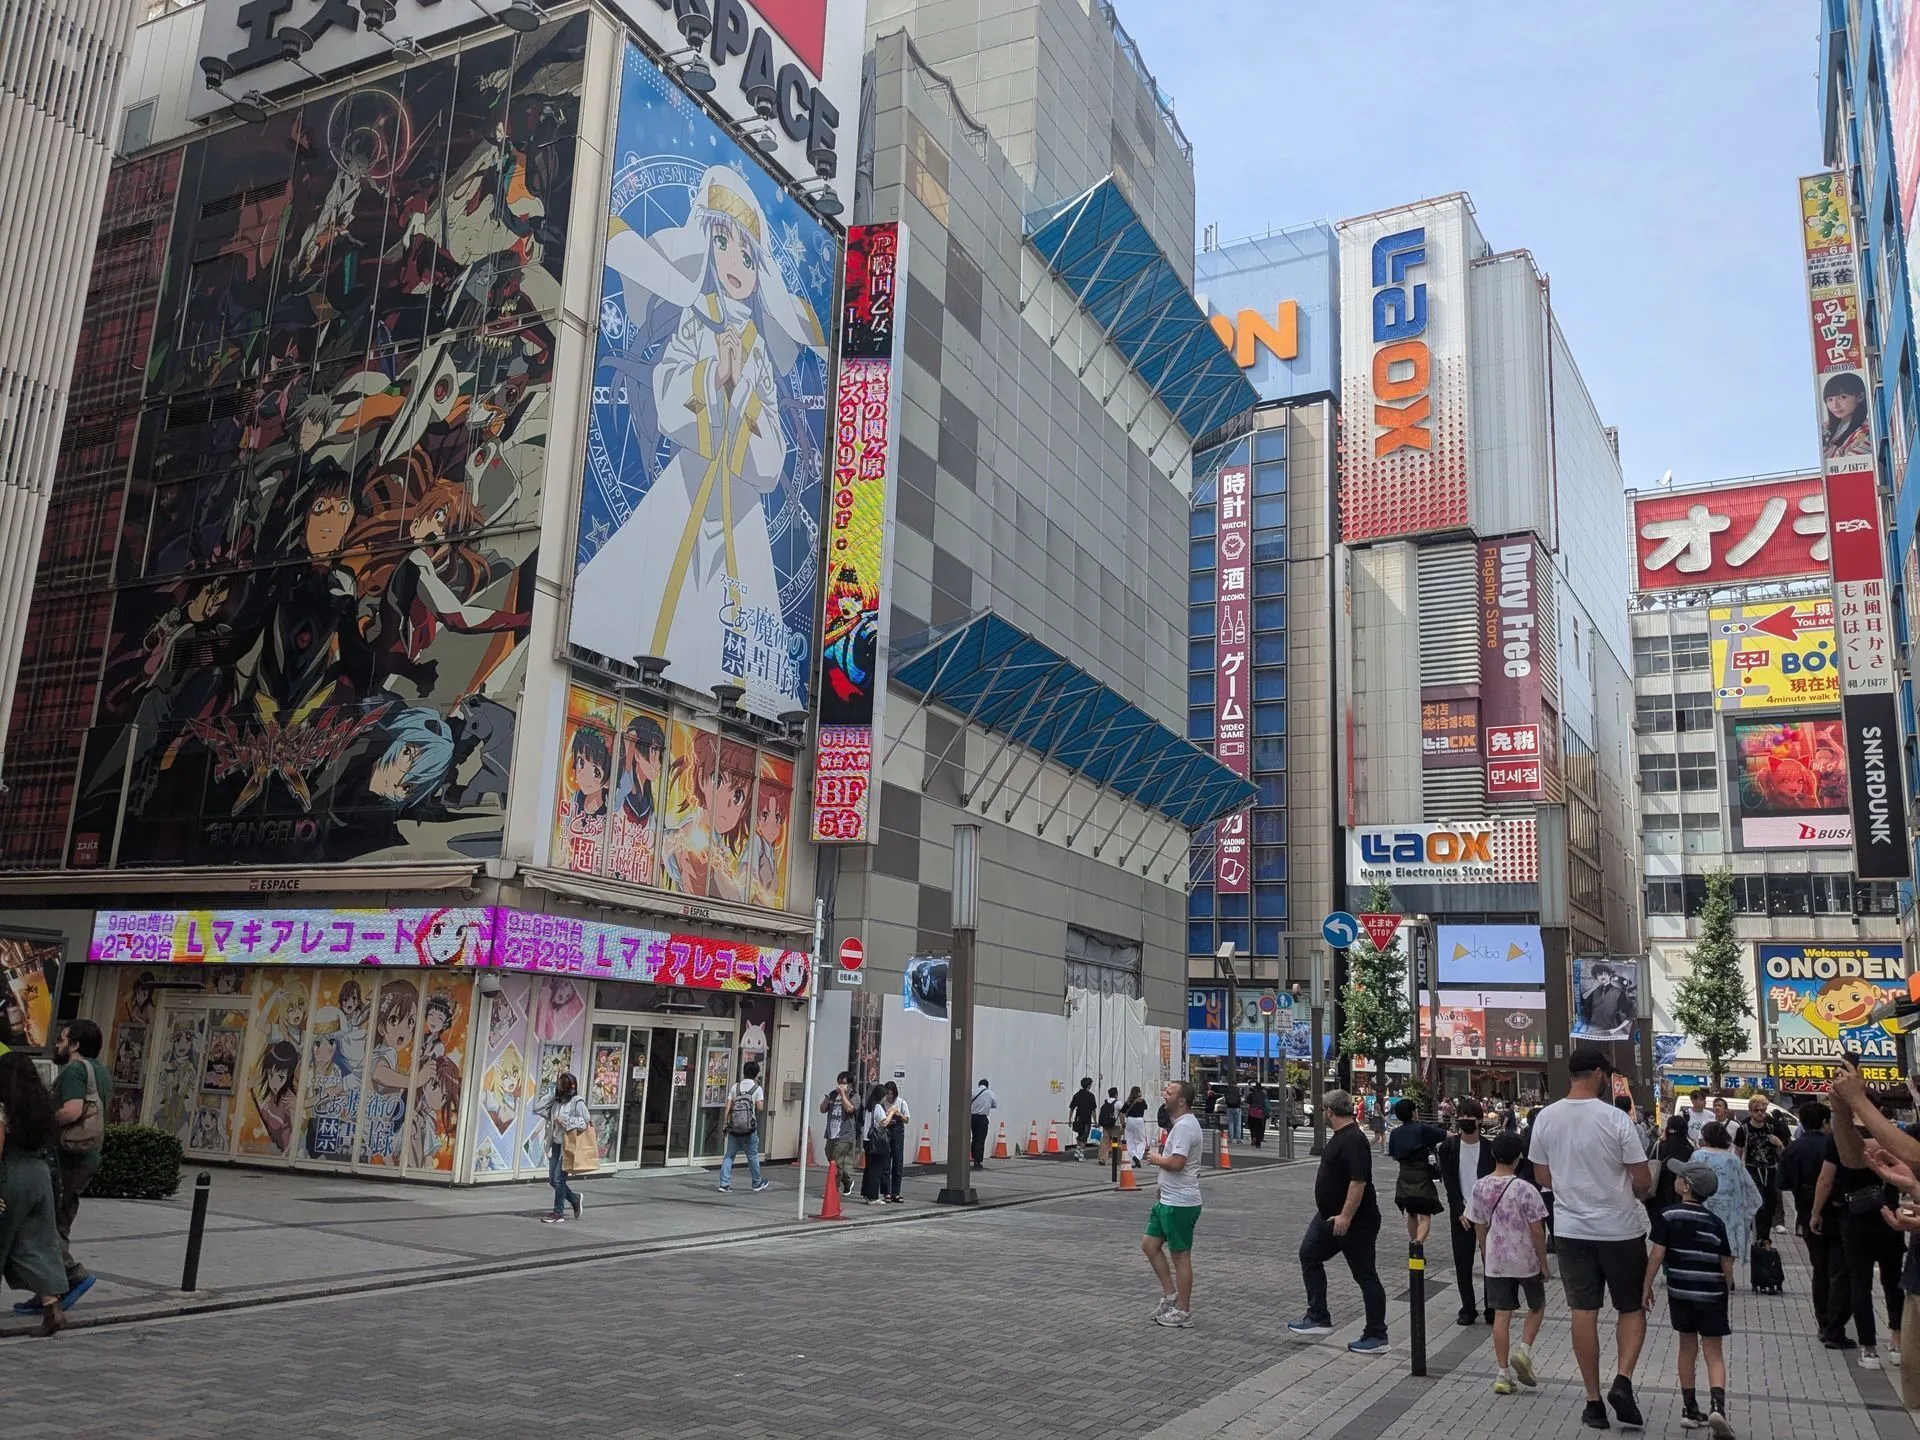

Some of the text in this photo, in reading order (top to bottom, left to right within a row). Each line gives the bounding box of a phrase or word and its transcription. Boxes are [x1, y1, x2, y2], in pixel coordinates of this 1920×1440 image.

[655, 0, 840, 178] PACE
[1811, 268, 1855, 288] 麻雀
[1222, 472, 1246, 520] 時計
[1221, 520, 1247, 530] WATCH
[1835, 519, 1872, 533] PSA
[720, 573, 748, 594] スマスロ
[1222, 566, 1246, 591] 酒
[1220, 594, 1246, 602] ALCOHOL
[1482, 547, 1499, 649] Flagship Store
[1498, 543, 1534, 678] Duty Free
[1816, 603, 1834, 616] 現
[719, 586, 808, 661] とある魔術の
[1797, 617, 1835, 627] You are
[1862, 581, 1885, 669] 和風耳かき
[721, 629, 801, 700] 禁書目録
[744, 676, 779, 693] インデックス
[1221, 651, 1245, 721] ゲーム
[1790, 676, 1840, 692] 現在地
[1847, 678, 1888, 689] 和ノ国7F
[1809, 693, 1831, 701] walk
[1422, 703, 1449, 716] 本店
[1220, 723, 1245, 731] VIDEO
[1422, 715, 1476, 731] 総合家電
[1220, 730, 1244, 738] GAME
[1490, 730, 1536, 752] 免税
[1490, 767, 1538, 785] 면세점
[1862, 726, 1892, 845] SNKRDUNK
[1219, 838, 1245, 846] TRADING
[1224, 845, 1241, 853] CARD
[1360, 865, 1493, 878] Home Electronics Store
[260, 879, 300, 891] ESPACE
[690, 907, 710, 918] ESPACE
[108, 913, 175, 933] 9月8日増台
[1367, 918, 1394, 927] 止まれ
[187, 918, 418, 954] Lマギアレコード
[1372, 928, 1390, 937] STOP
[1803, 948, 1869, 958] Welcome to
[1766, 956, 1906, 979] ONODEN
[315, 1116, 395, 1157] 禁書録
